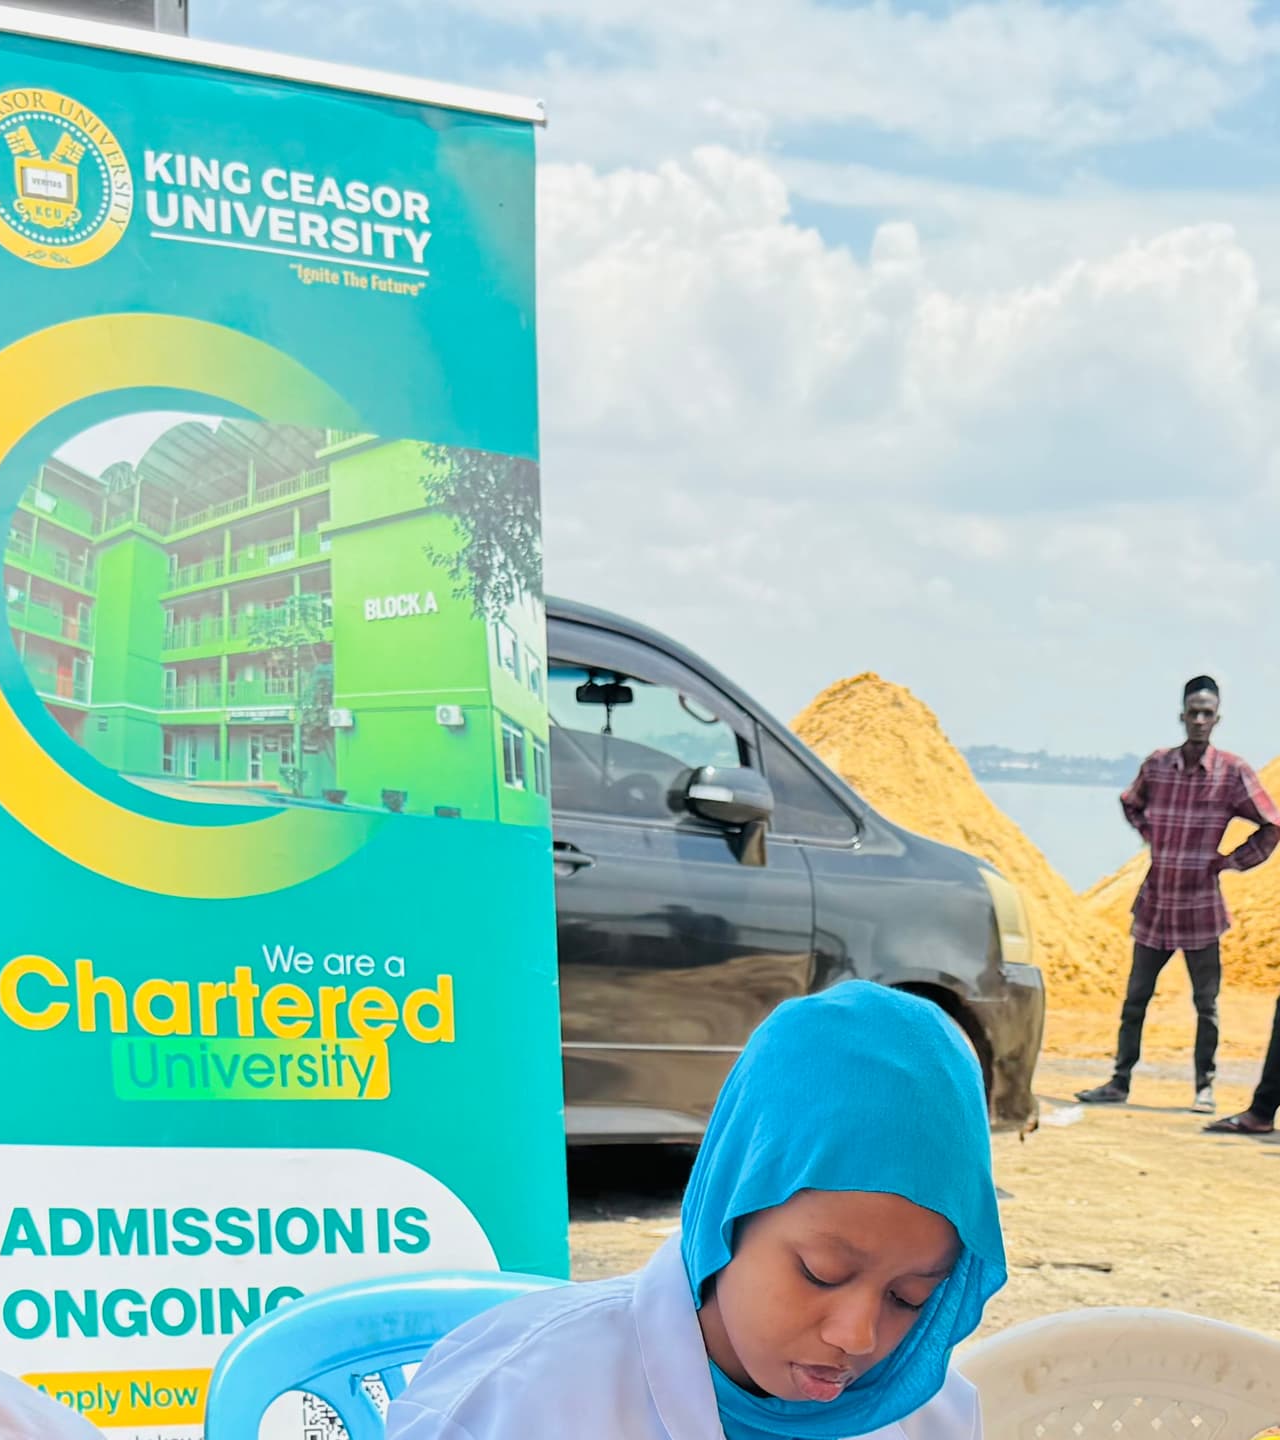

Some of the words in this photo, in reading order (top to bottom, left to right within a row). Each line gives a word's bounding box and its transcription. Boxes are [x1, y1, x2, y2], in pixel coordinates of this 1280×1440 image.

[59, 98, 131, 231] UNIVERSITY
[144, 150, 251, 195] KING
[261, 168, 430, 224] CEASOR
[146, 189, 432, 264] UNIVERSITY
[342, 270, 368, 289] The
[365, 592, 421, 621] BLOCK
[424, 591, 438, 615] A
[262, 944, 314, 974] We
[323, 952, 376, 977] are
[384, 954, 406, 977] a
[128, 1041, 376, 1098] University
[0, 1207, 365, 1257] ADMISSION
[377, 1207, 431, 1254] IS
[38, 1382, 121, 1416] pply
[130, 1381, 199, 1408] Now
